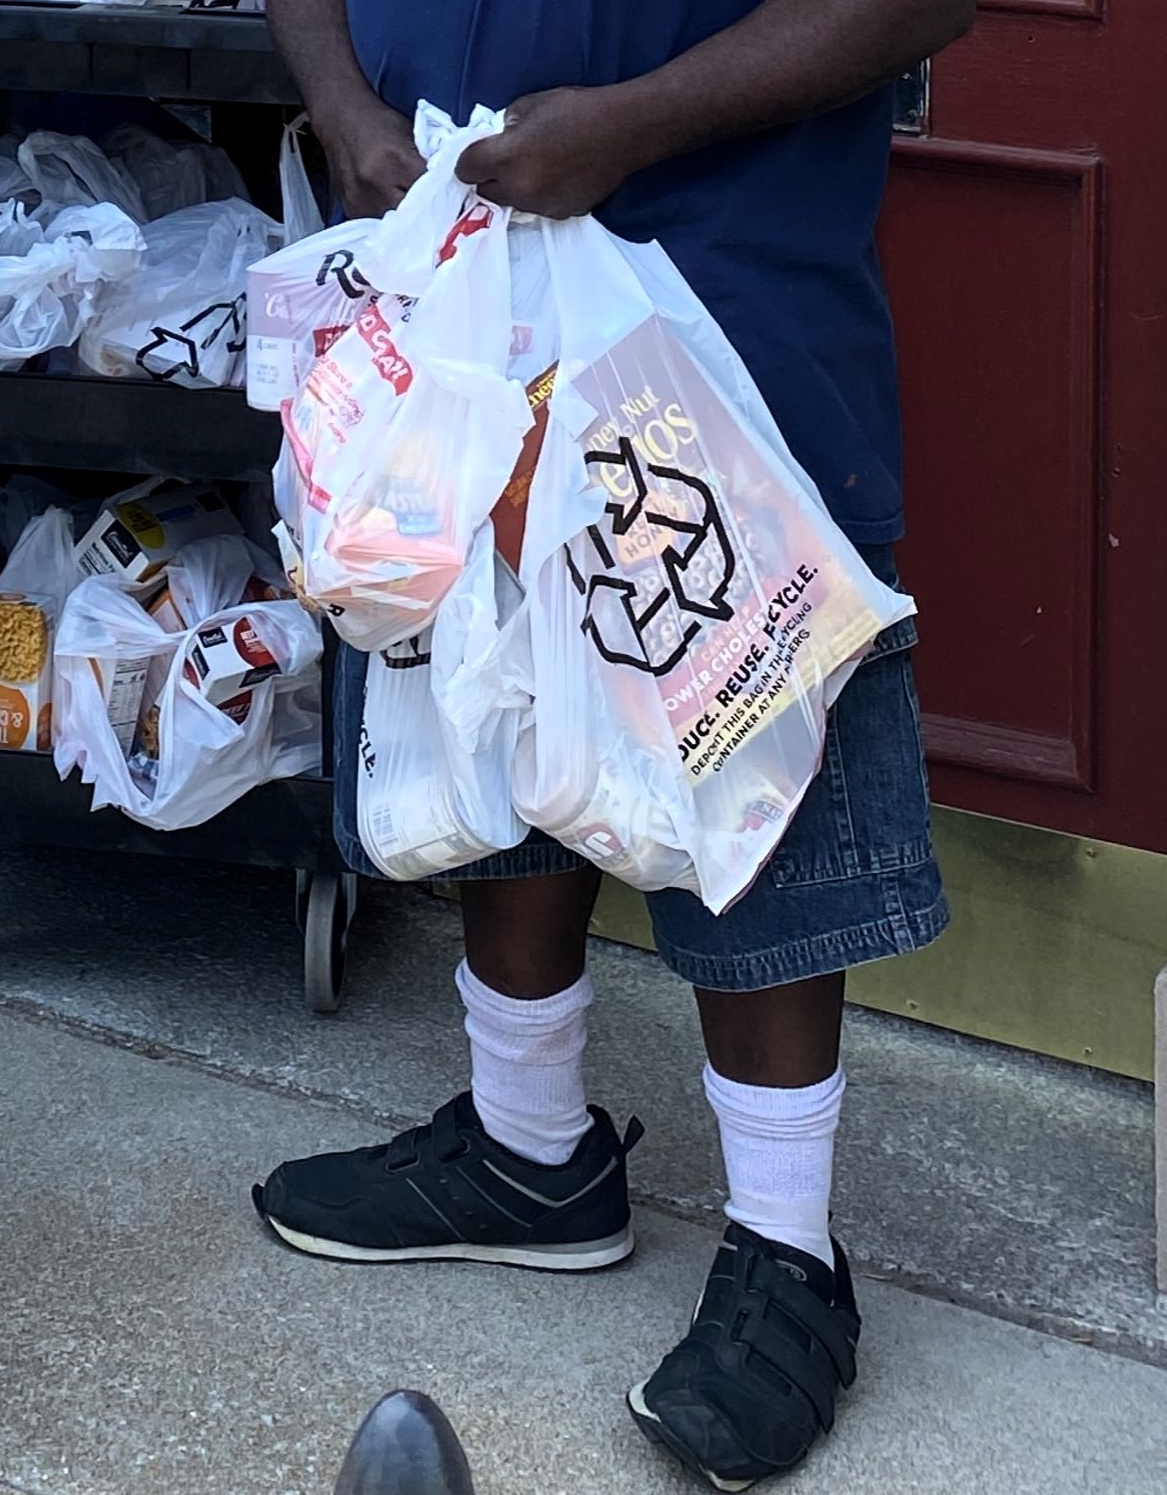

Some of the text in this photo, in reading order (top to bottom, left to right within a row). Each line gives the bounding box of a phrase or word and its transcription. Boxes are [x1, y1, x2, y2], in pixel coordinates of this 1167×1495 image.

[619, 383, 661, 424] Nut
[715, 643, 770, 708] REUSE.
[759, 700, 772, 715] AT
[769, 675, 788, 701] ANY
[721, 707, 746, 734] THIS
[744, 686, 764, 709] BAG
